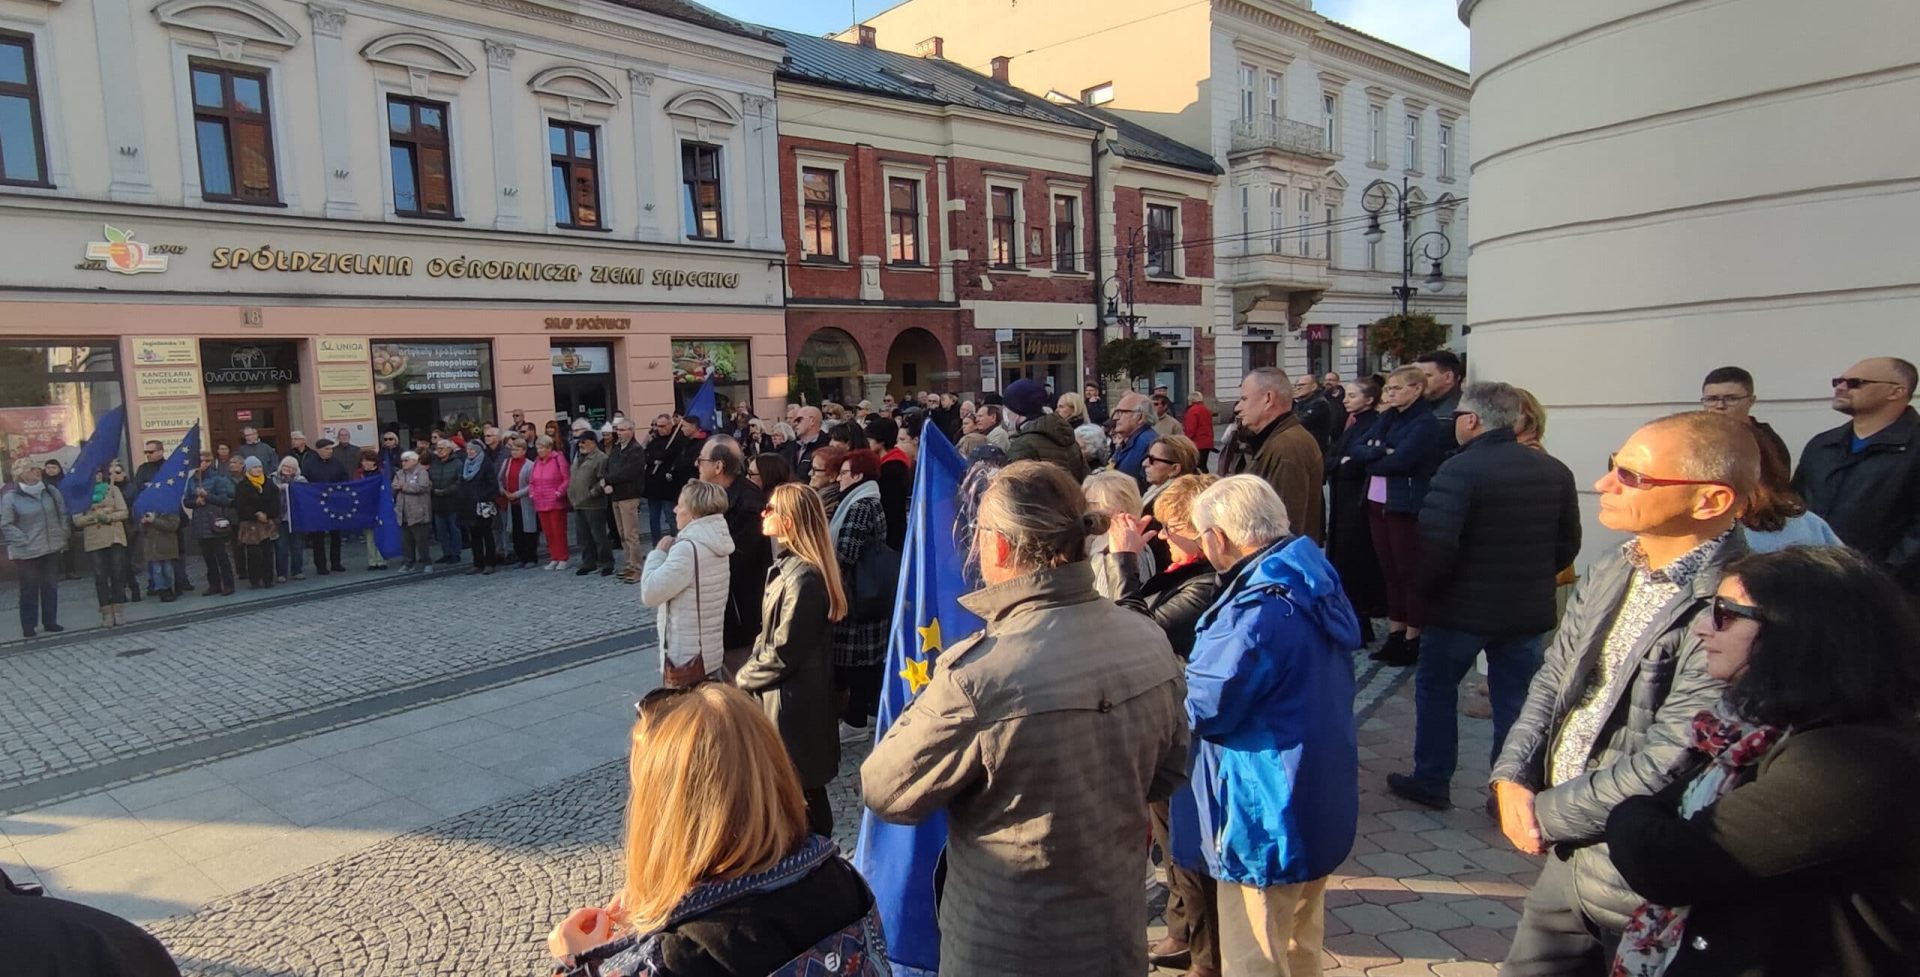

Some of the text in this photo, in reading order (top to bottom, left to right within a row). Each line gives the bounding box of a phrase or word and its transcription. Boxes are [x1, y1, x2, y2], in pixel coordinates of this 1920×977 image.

[212, 244, 741, 291] SPÓŁDZIELNIA OGRODNICZA ZIEMI SĄDECKIEJ
[243, 311, 260, 325] 18
[544, 314, 632, 330] SKLEP SPOŻYWCZY
[336, 343, 364, 351] UNIQA
[427, 358, 478, 368] monopolowe
[142, 377, 194, 385] ADWOKACKA
[205, 369, 293, 383] OWOCOWY RAJ
[408, 382, 436, 391] owoce
[443, 381, 480, 391] warzywa
[145, 418, 184, 428] OPTIMUM
